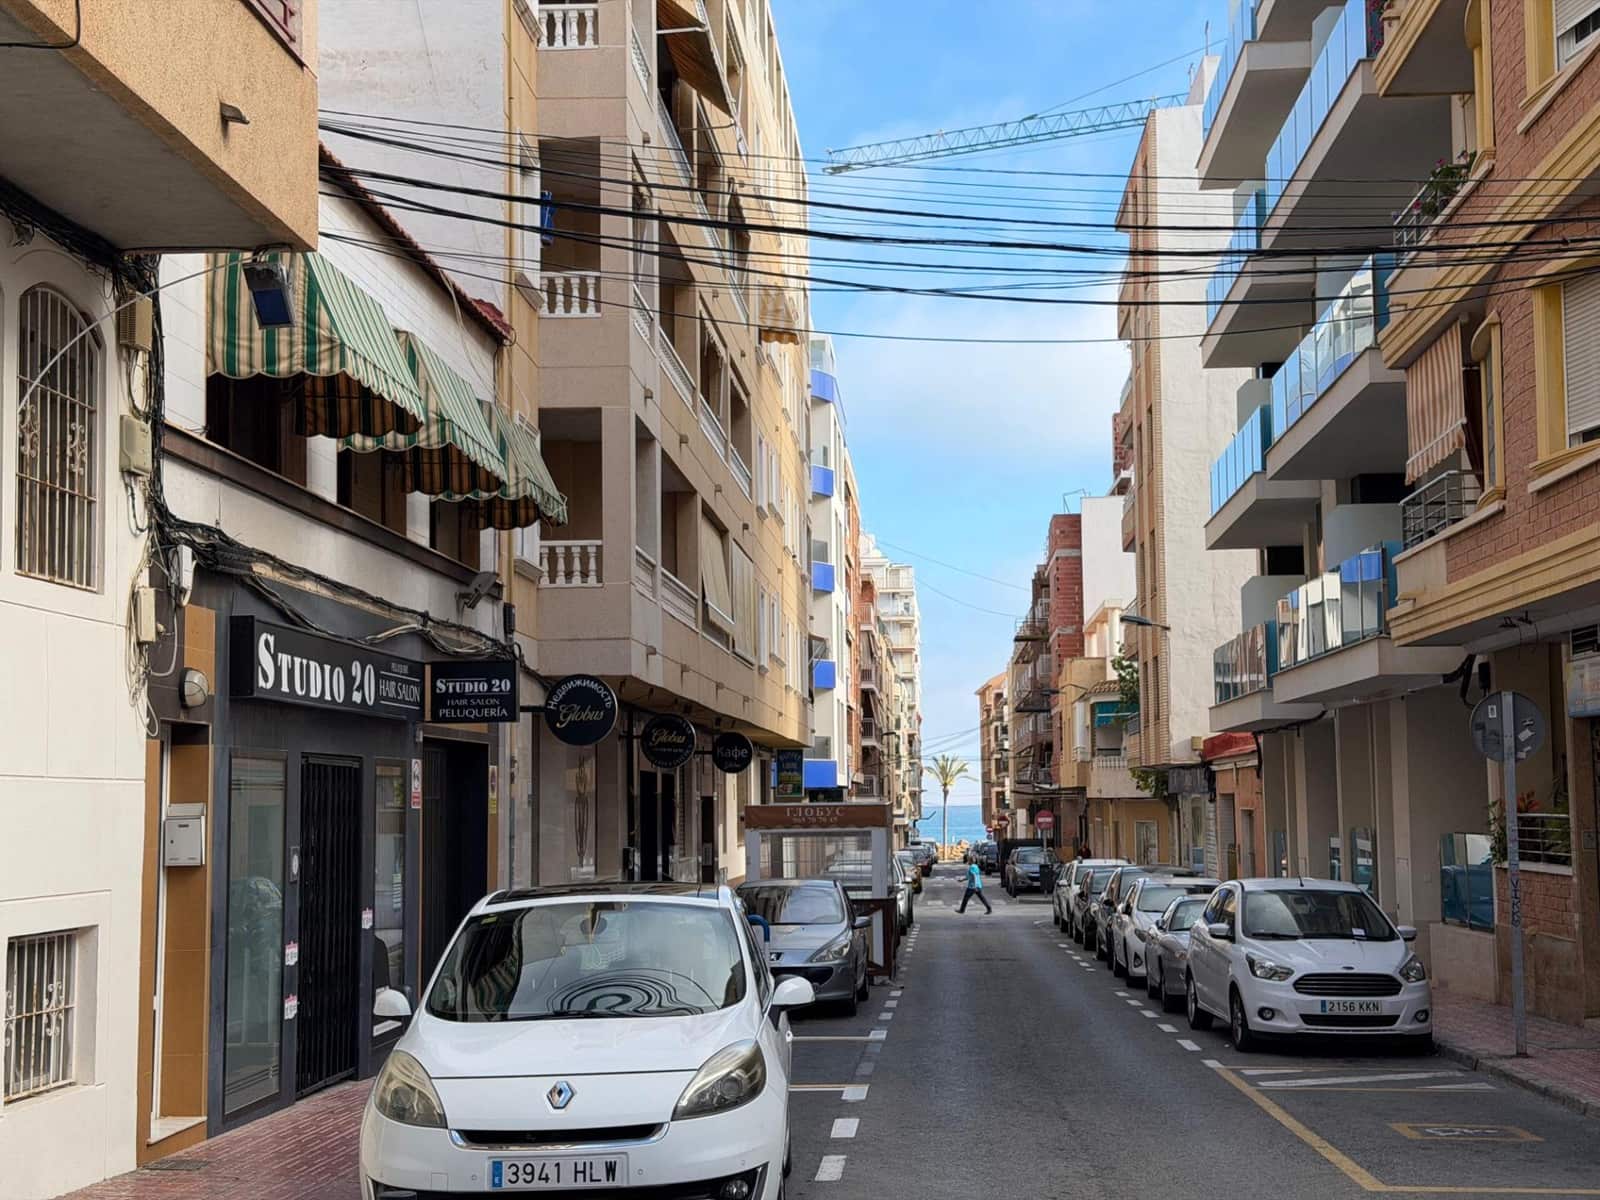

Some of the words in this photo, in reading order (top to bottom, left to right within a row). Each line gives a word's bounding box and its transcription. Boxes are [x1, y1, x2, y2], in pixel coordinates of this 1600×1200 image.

[351, 660, 376, 706] 20
[379, 678, 397, 700] HAIR
[397, 682, 421, 703] SALON
[491, 678, 511, 692] 20
[469, 698, 500, 706] SALON
[547, 679, 613, 710] Недвижимость
[439, 706, 508, 719] PELUQUERÍA
[556, 703, 605, 728] Globus
[787, 807, 845, 817] ГЛОБУС
[1328, 1001, 1356, 1012] 2156
[1359, 1001, 1379, 1012] KKN
[507, 1162, 561, 1184] 3941
[574, 1160, 617, 1183] HLW
